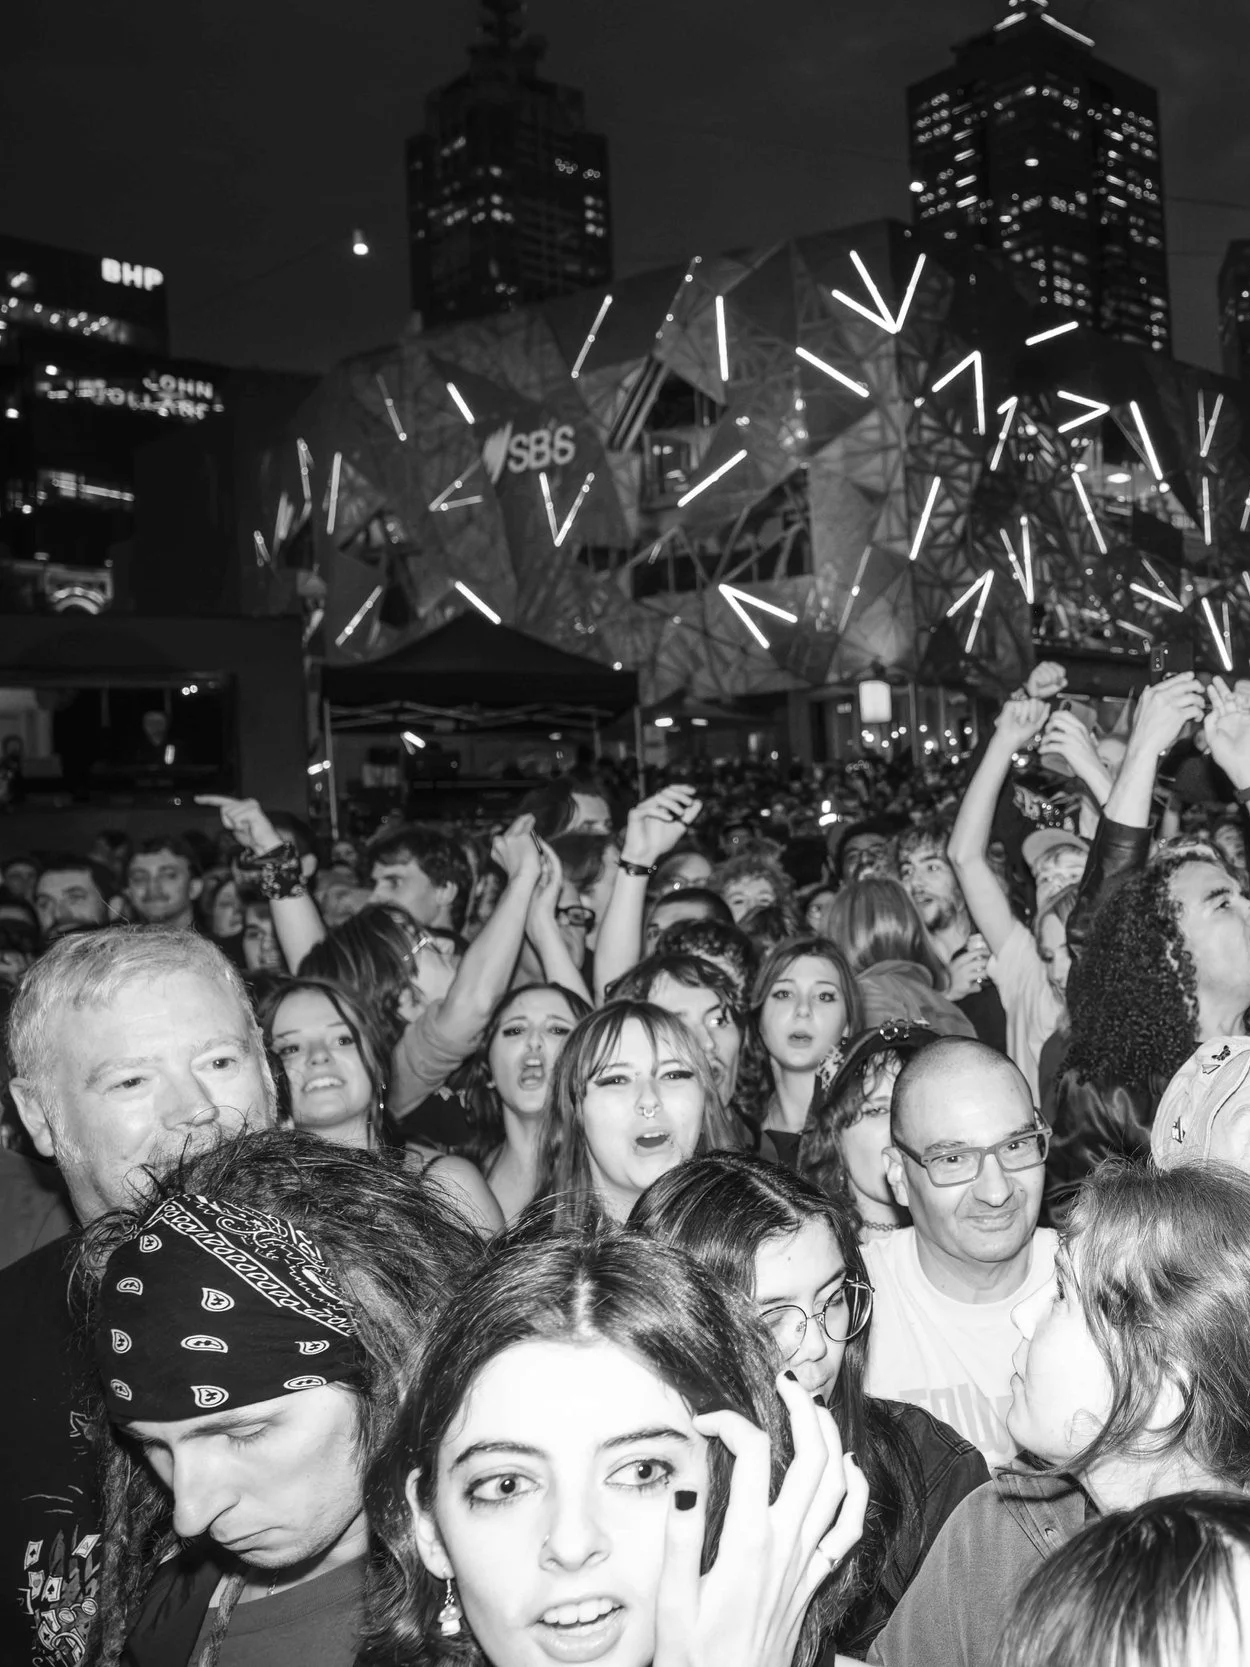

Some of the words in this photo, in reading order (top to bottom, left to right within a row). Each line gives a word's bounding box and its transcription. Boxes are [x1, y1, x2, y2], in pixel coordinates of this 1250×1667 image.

[101, 257, 164, 291] BHP
[142, 374, 213, 399] JOHN
[508, 424, 576, 474] SBS
